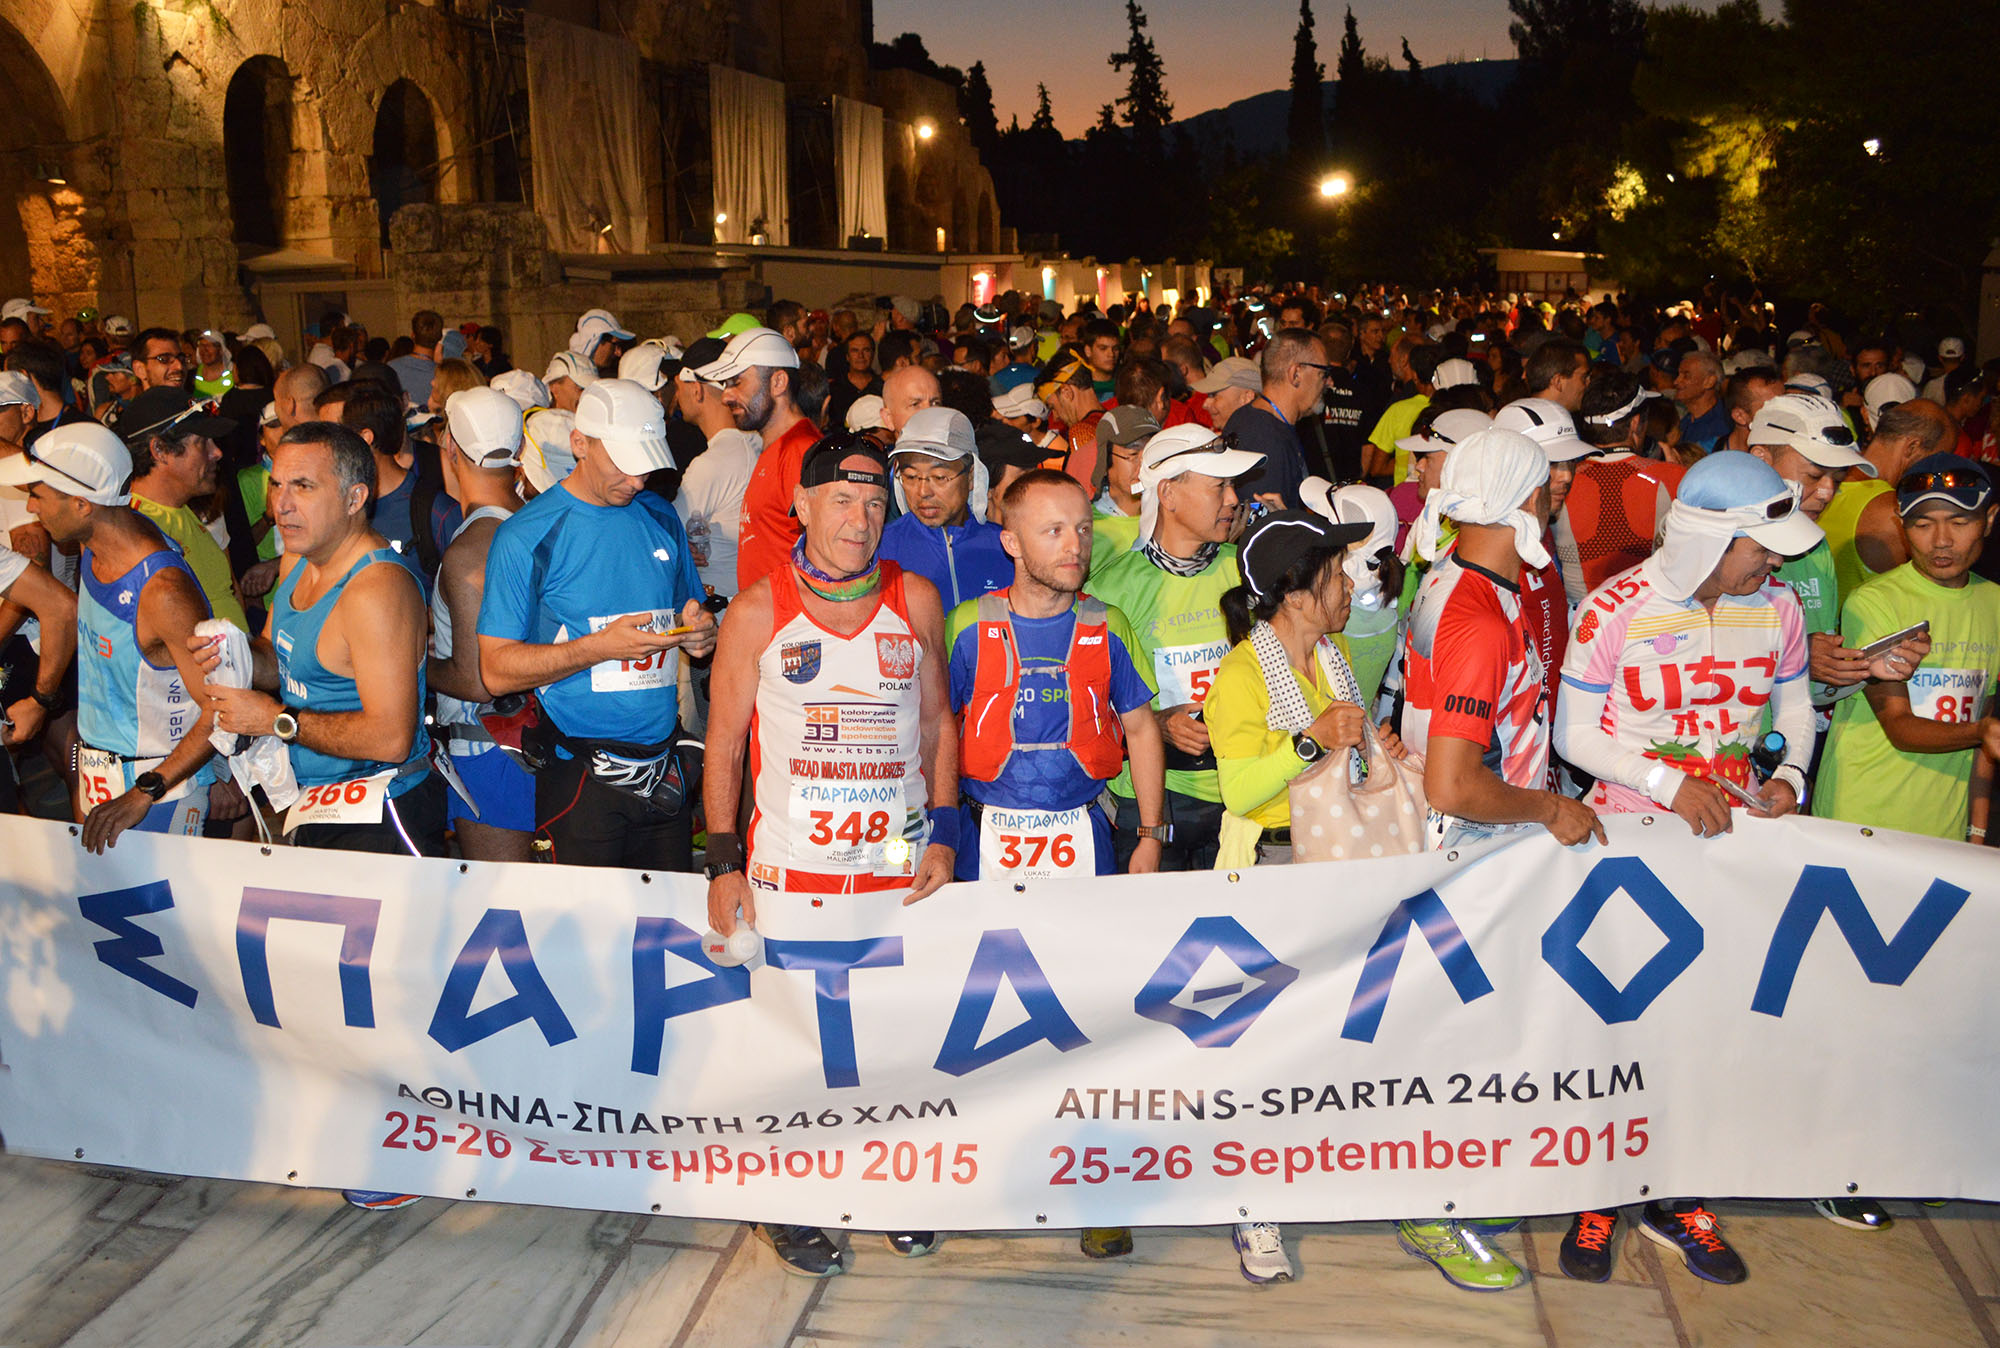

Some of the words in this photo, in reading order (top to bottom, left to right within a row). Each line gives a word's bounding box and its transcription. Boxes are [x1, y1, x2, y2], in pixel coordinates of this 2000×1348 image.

[1164, 643, 1232, 666] ΣΠΑΡΤΑΘΛ
[879, 682, 913, 691] POLAND
[1190, 667, 1220, 703] 5
[1623, 651, 1779, 712] いちご
[1444, 694, 1492, 720] OTORI
[1934, 695, 1974, 723] 85
[821, 761, 857, 780] MIASTA
[299, 779, 368, 812] 366
[800, 786, 897, 803] ΣΠΑΡΤΑΘΛΟΝ
[808, 810, 890, 847] 348
[991, 811, 1080, 829] ΣΠΑΡΤΑΘΛΟΝ
[999, 833, 1076, 869] 376
[80, 856, 1971, 1088] ΣΠΑΡΤΑΘΛΟΝ
[398, 1084, 744, 1134] ΑΘΗΝΑ-ΣΠΑΡΤΗ
[756, 1109, 843, 1134] 246
[853, 1098, 958, 1125] ΧΛΜ
[1055, 1077, 1435, 1120] ATHENS-SPARTA
[1447, 1072, 1539, 1104] 246
[1553, 1062, 1645, 1101] KLM
[382, 1111, 512, 1159] 25-26
[523, 1137, 844, 1185] Σεπτεμβρίου
[861, 1140, 978, 1185] 2015
[1049, 1145, 1193, 1185] 25-26
[1212, 1130, 1512, 1184] September
[1530, 1117, 1650, 1168] 2015
